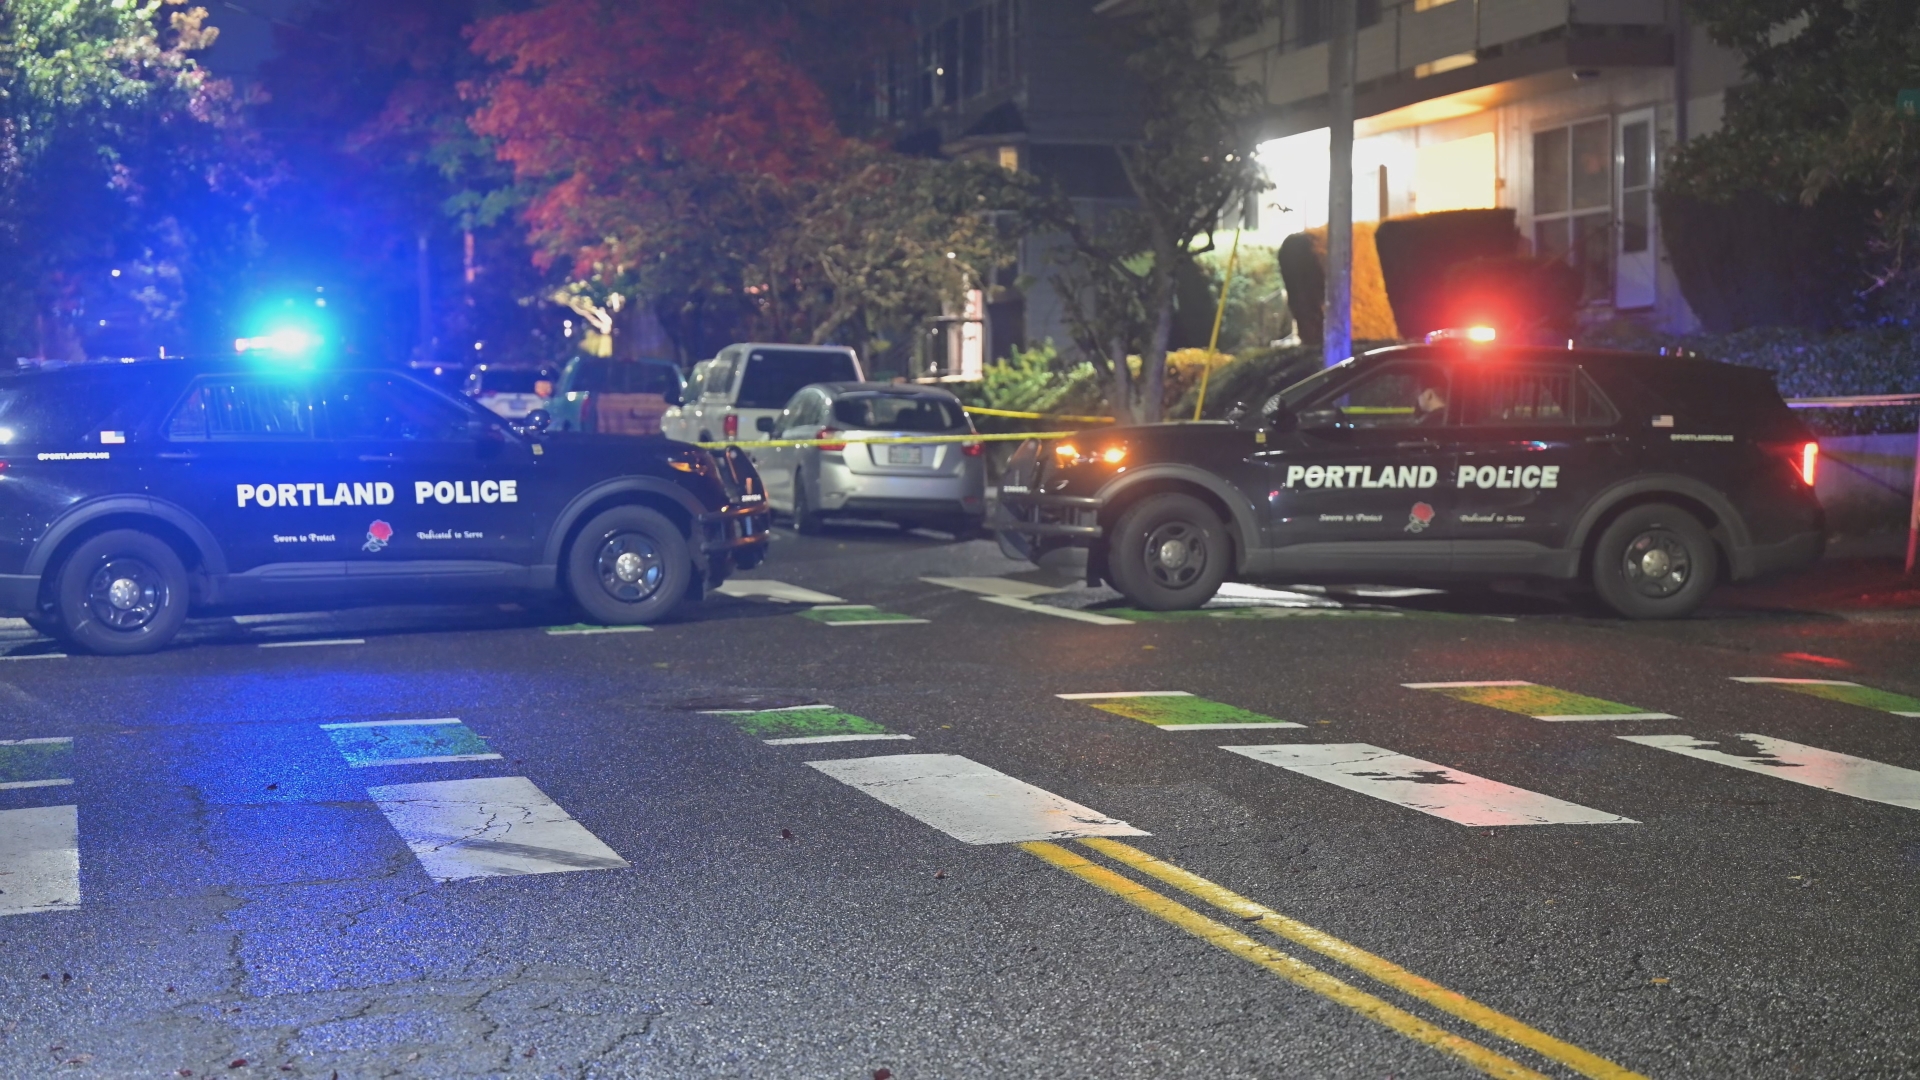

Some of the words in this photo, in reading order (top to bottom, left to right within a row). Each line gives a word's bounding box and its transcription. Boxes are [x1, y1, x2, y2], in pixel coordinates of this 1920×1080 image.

[1286, 465, 1438, 489] PORTLAND
[1457, 465, 1560, 489] POLICE
[236, 482, 395, 508] PORTLAND
[414, 480, 518, 504] POLICE
[273, 534, 298, 543] Sworn
[299, 533, 307, 543] to
[308, 532, 336, 543] Protect
[416, 529, 452, 540] Dedicated
[454, 531, 462, 539] to
